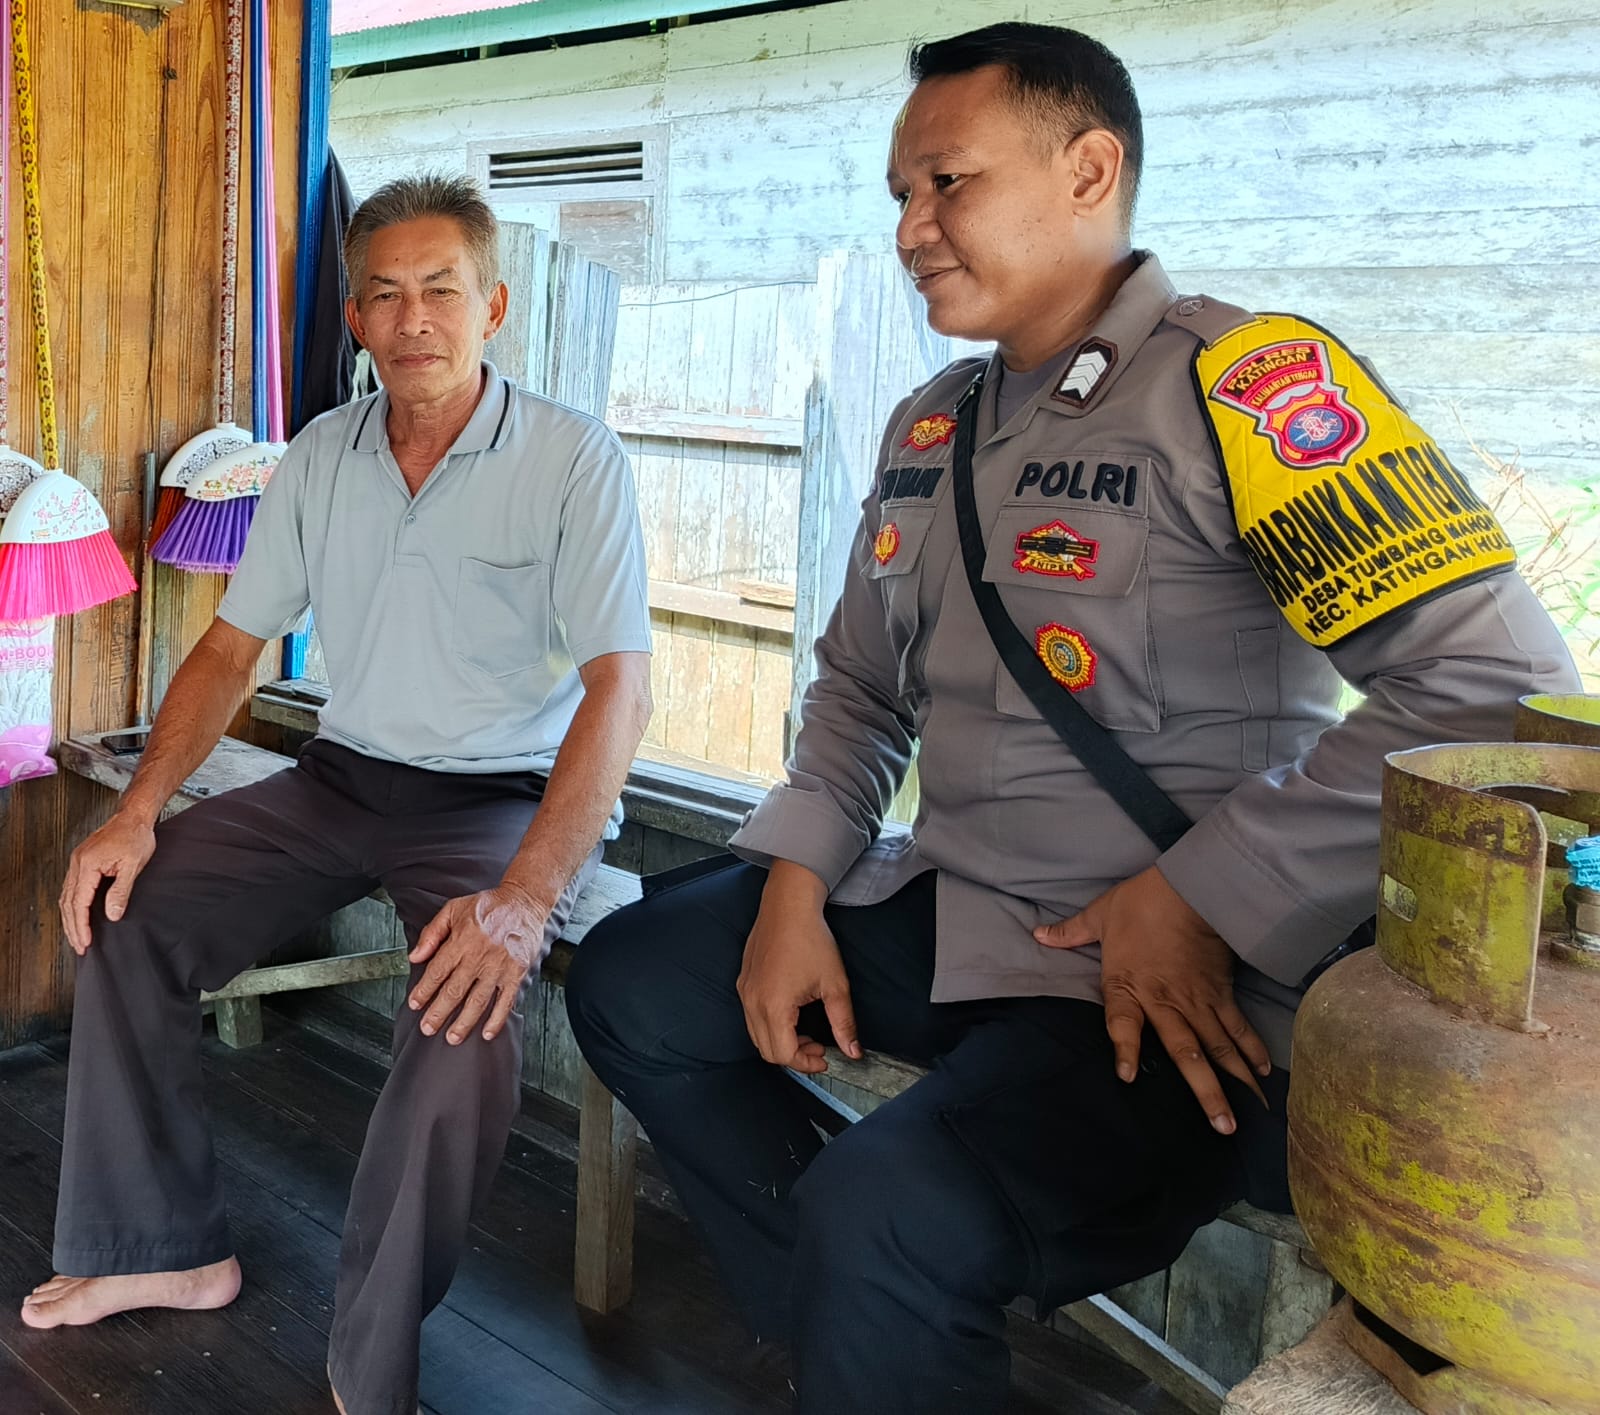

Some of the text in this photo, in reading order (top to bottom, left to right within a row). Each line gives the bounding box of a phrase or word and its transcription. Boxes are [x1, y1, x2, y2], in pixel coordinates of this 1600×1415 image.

[1226, 346, 1311, 390] POLRES
[1236, 352, 1307, 390] KATINGAN
[1015, 460, 1138, 507] POLRI
[1029, 558, 1074, 572] SNIPER
[1301, 575, 1351, 614] DESA
[1344, 527, 1447, 583] TUMBANG
[1304, 531, 1512, 638] KEC. KATINGAN HUL
